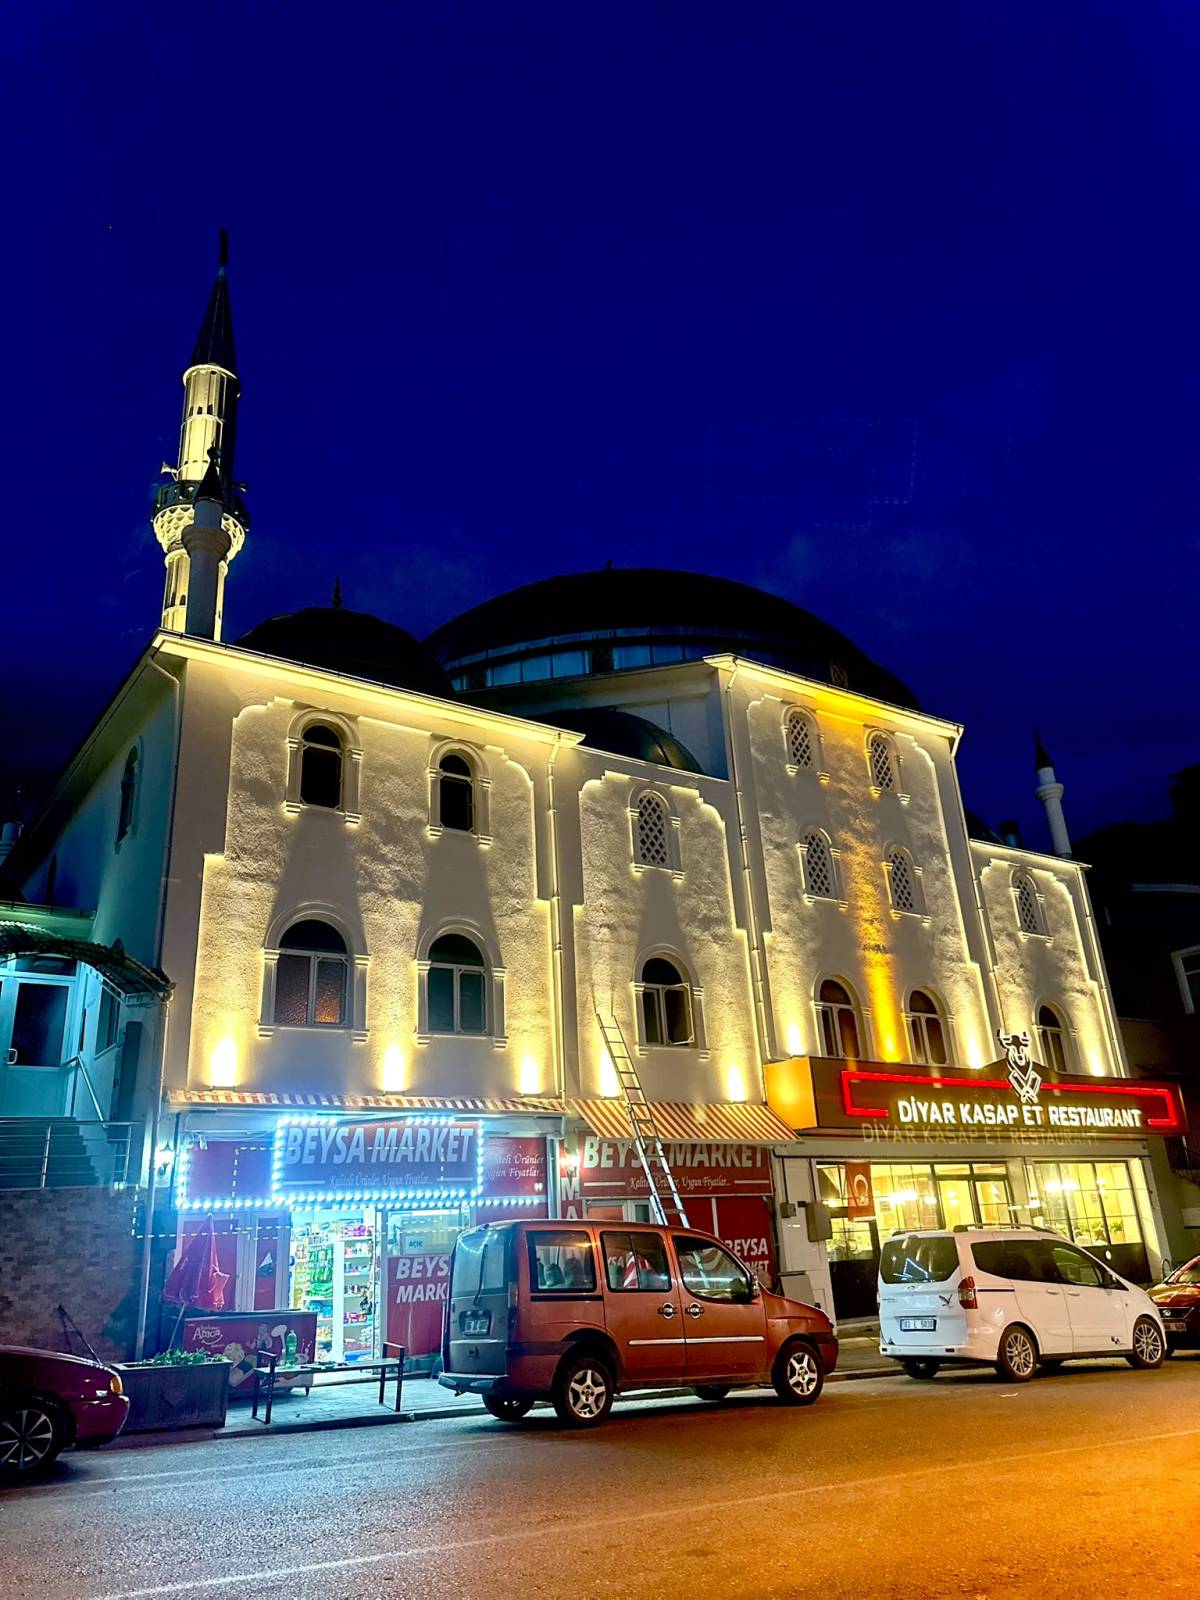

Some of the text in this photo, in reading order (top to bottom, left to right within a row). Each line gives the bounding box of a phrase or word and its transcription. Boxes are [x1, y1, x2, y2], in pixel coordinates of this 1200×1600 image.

[897, 1096, 1141, 1127] DİYAR KASAP ET RESTAURANT
[285, 1127, 474, 1164] BEYSA MARKET
[669, 1143, 764, 1168] MARKET
[396, 1255, 450, 1280] BEYS
[396, 1282, 448, 1304] MARK
